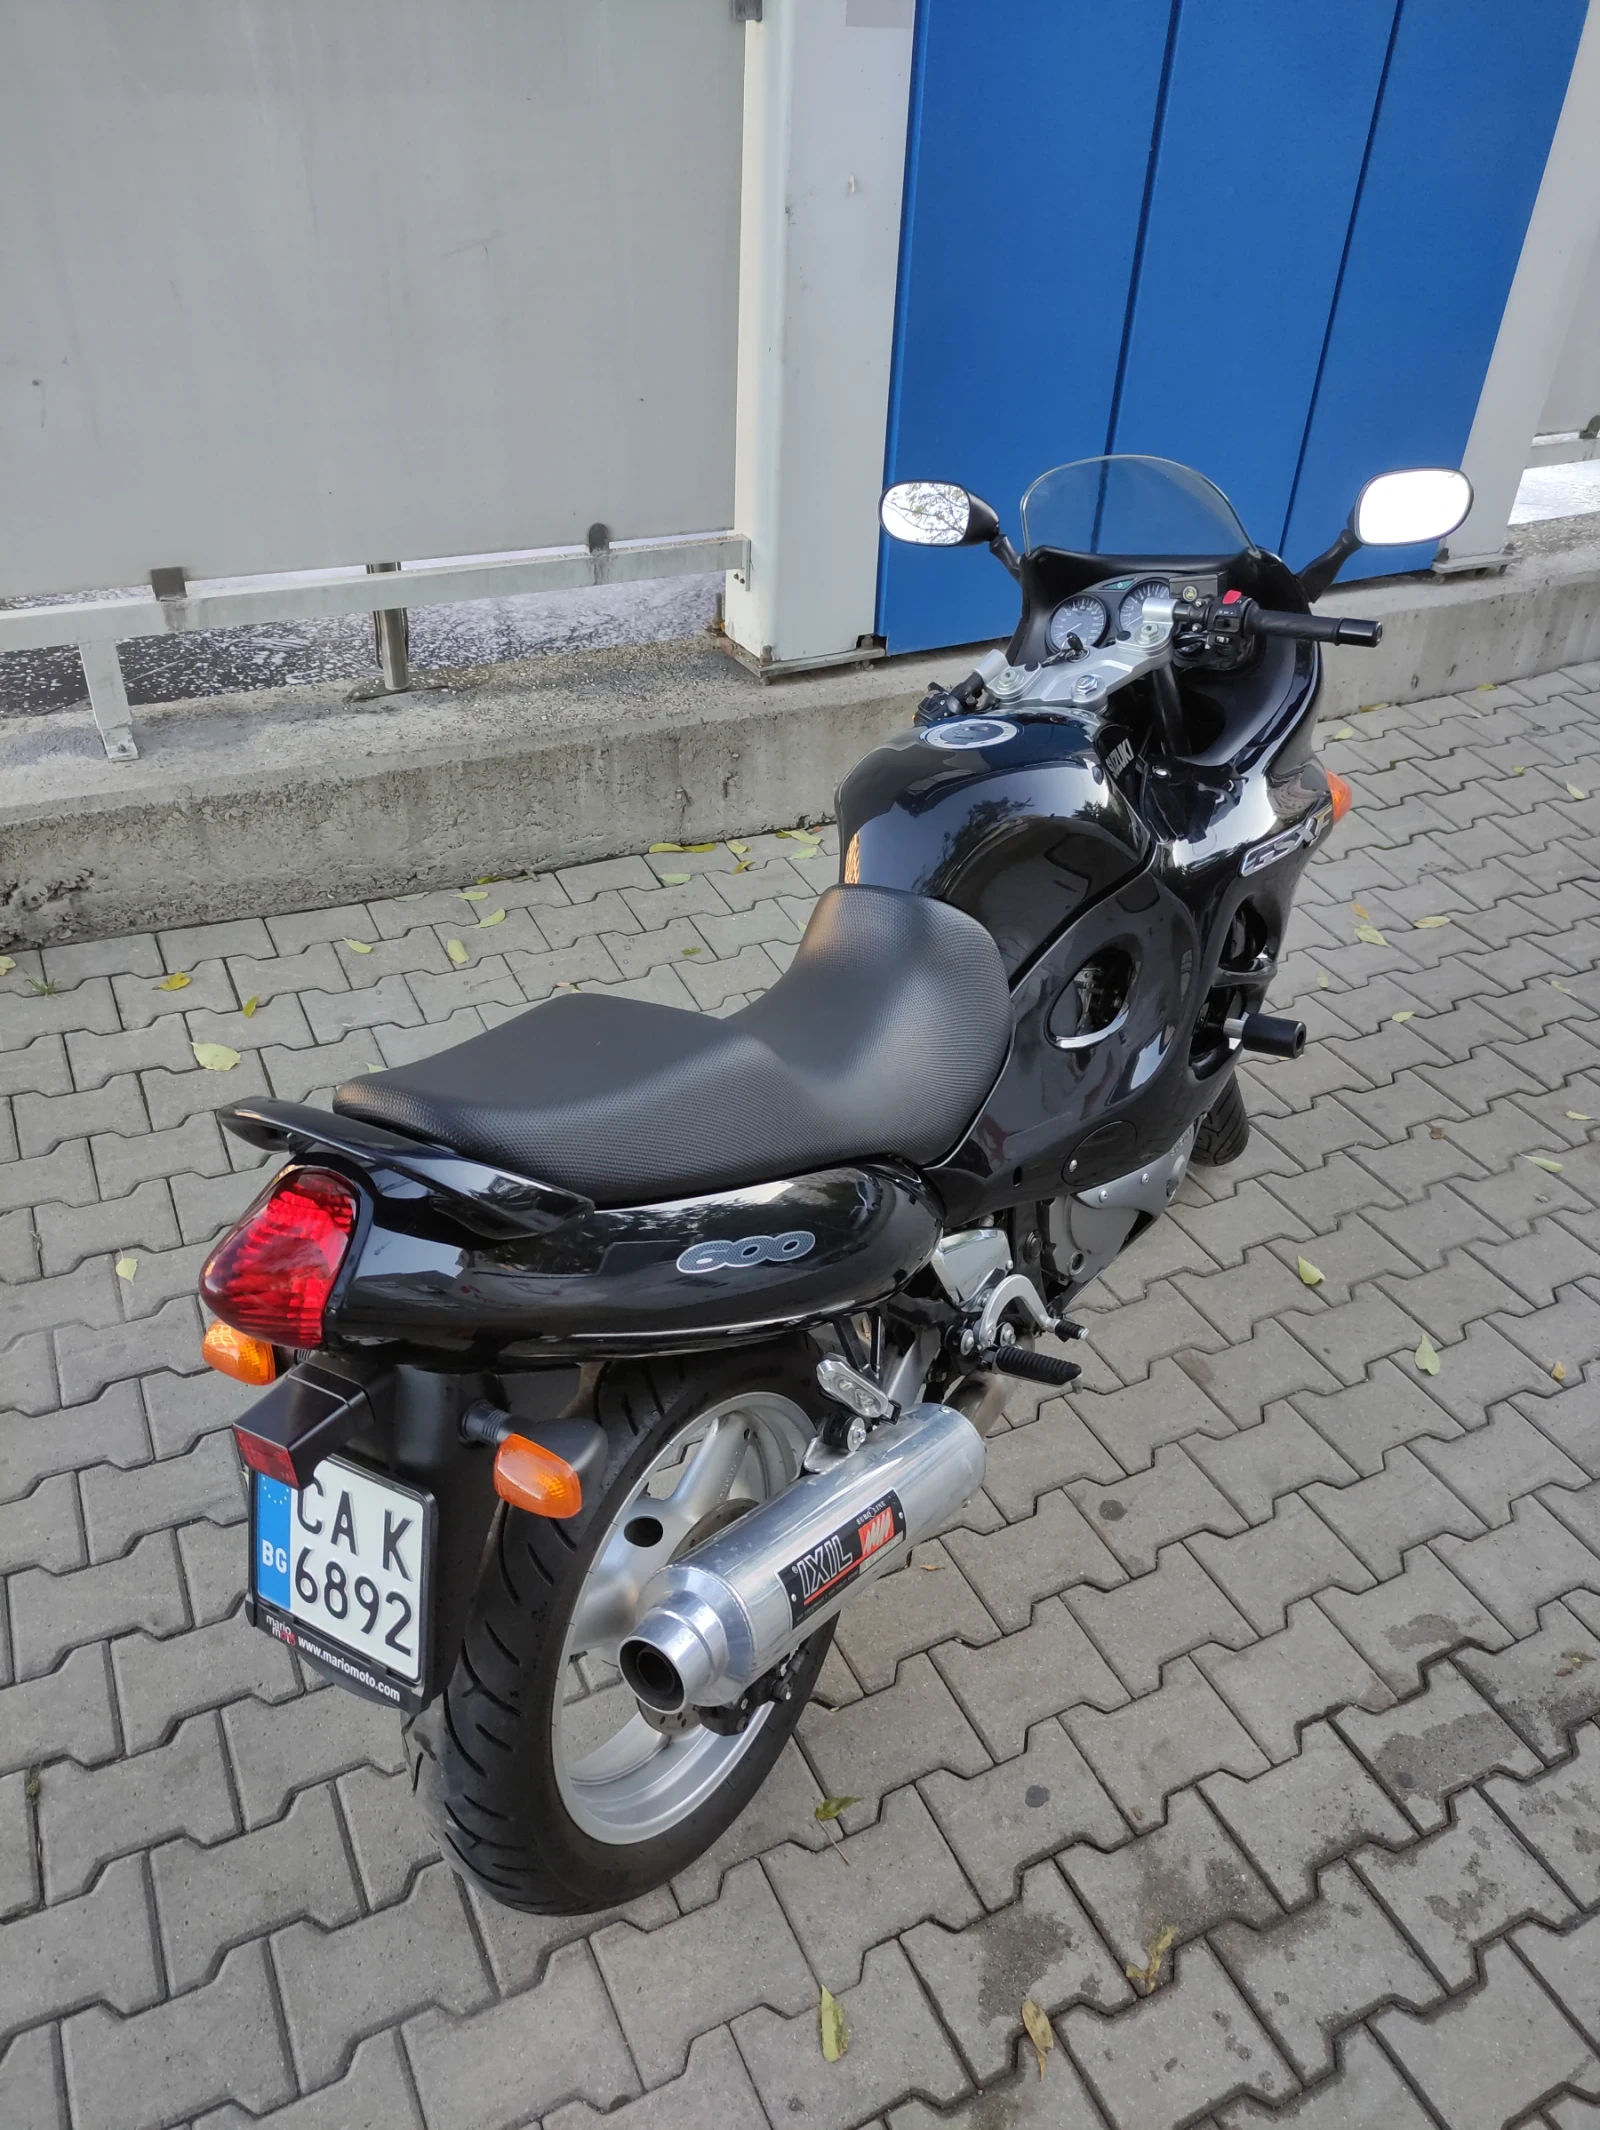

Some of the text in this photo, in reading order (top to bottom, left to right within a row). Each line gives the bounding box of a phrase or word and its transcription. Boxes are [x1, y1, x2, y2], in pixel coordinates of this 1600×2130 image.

[676, 1231, 816, 1273] 600
[262, 1539, 288, 1574] BG
[796, 1535, 854, 1599] IXIL
[266, 1615, 291, 1635] mario
[295, 1547, 414, 1657] 6892
[298, 1636, 400, 1702] www.mariomoto.com
